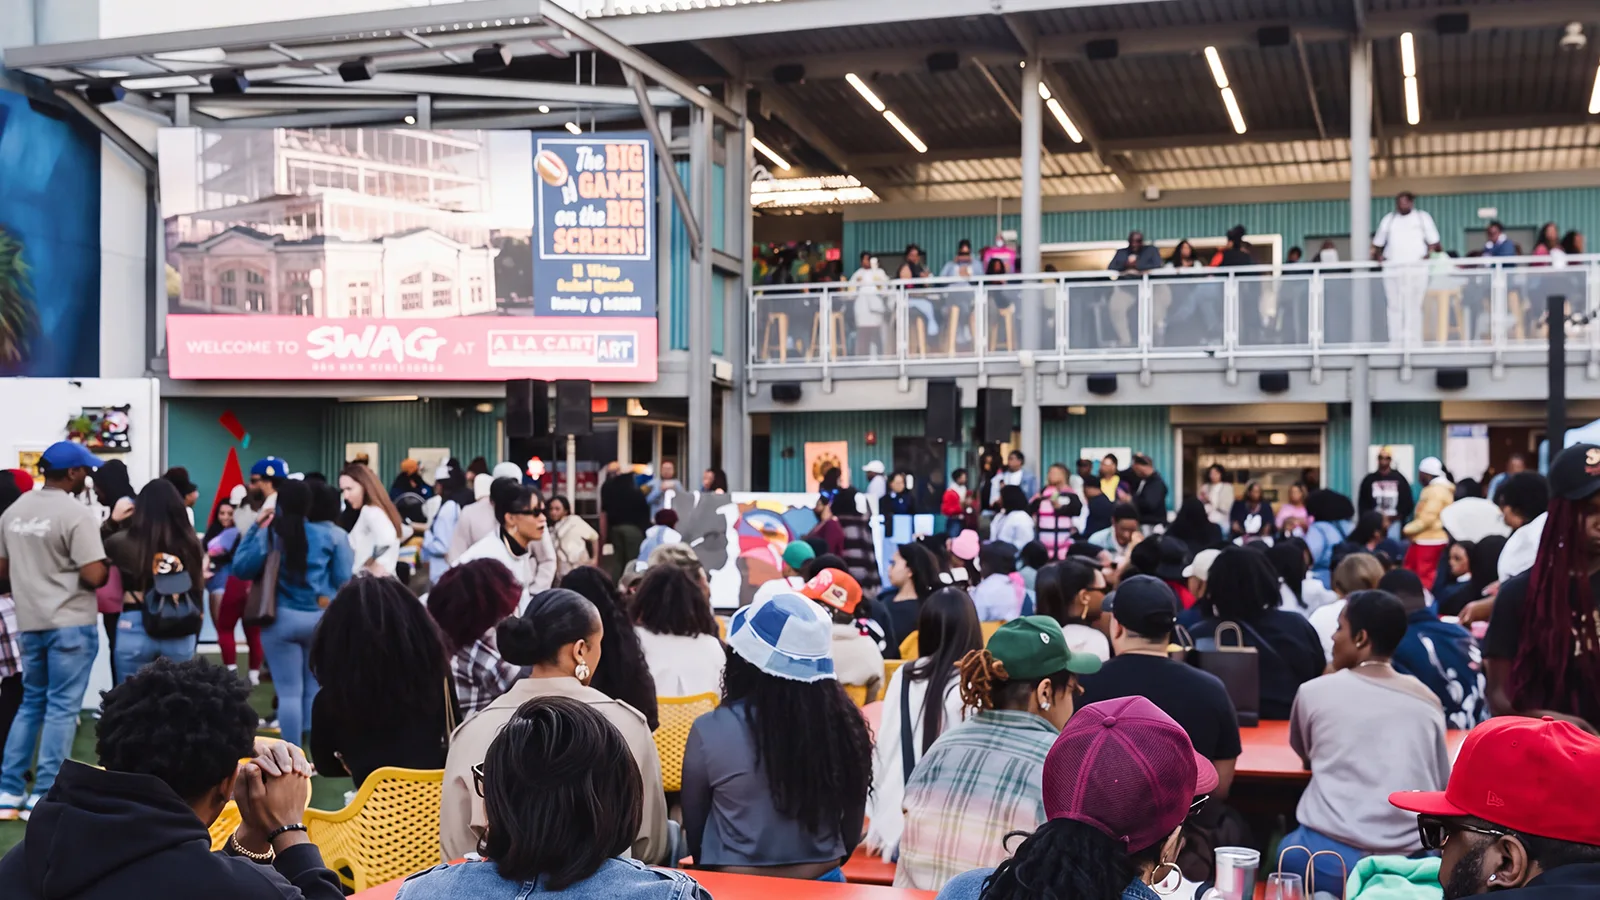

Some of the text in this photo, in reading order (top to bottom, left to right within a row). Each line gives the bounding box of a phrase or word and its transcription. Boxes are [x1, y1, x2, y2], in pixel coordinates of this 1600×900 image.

[576, 144, 643, 172] The BIG
[578, 171, 644, 199] GAME
[554, 200, 644, 227] on the BIG
[553, 227, 644, 255] SCREEN!
[185, 325, 476, 364] WELCOME TO SWAG AT
[493, 335, 633, 360] A LA CART ART
